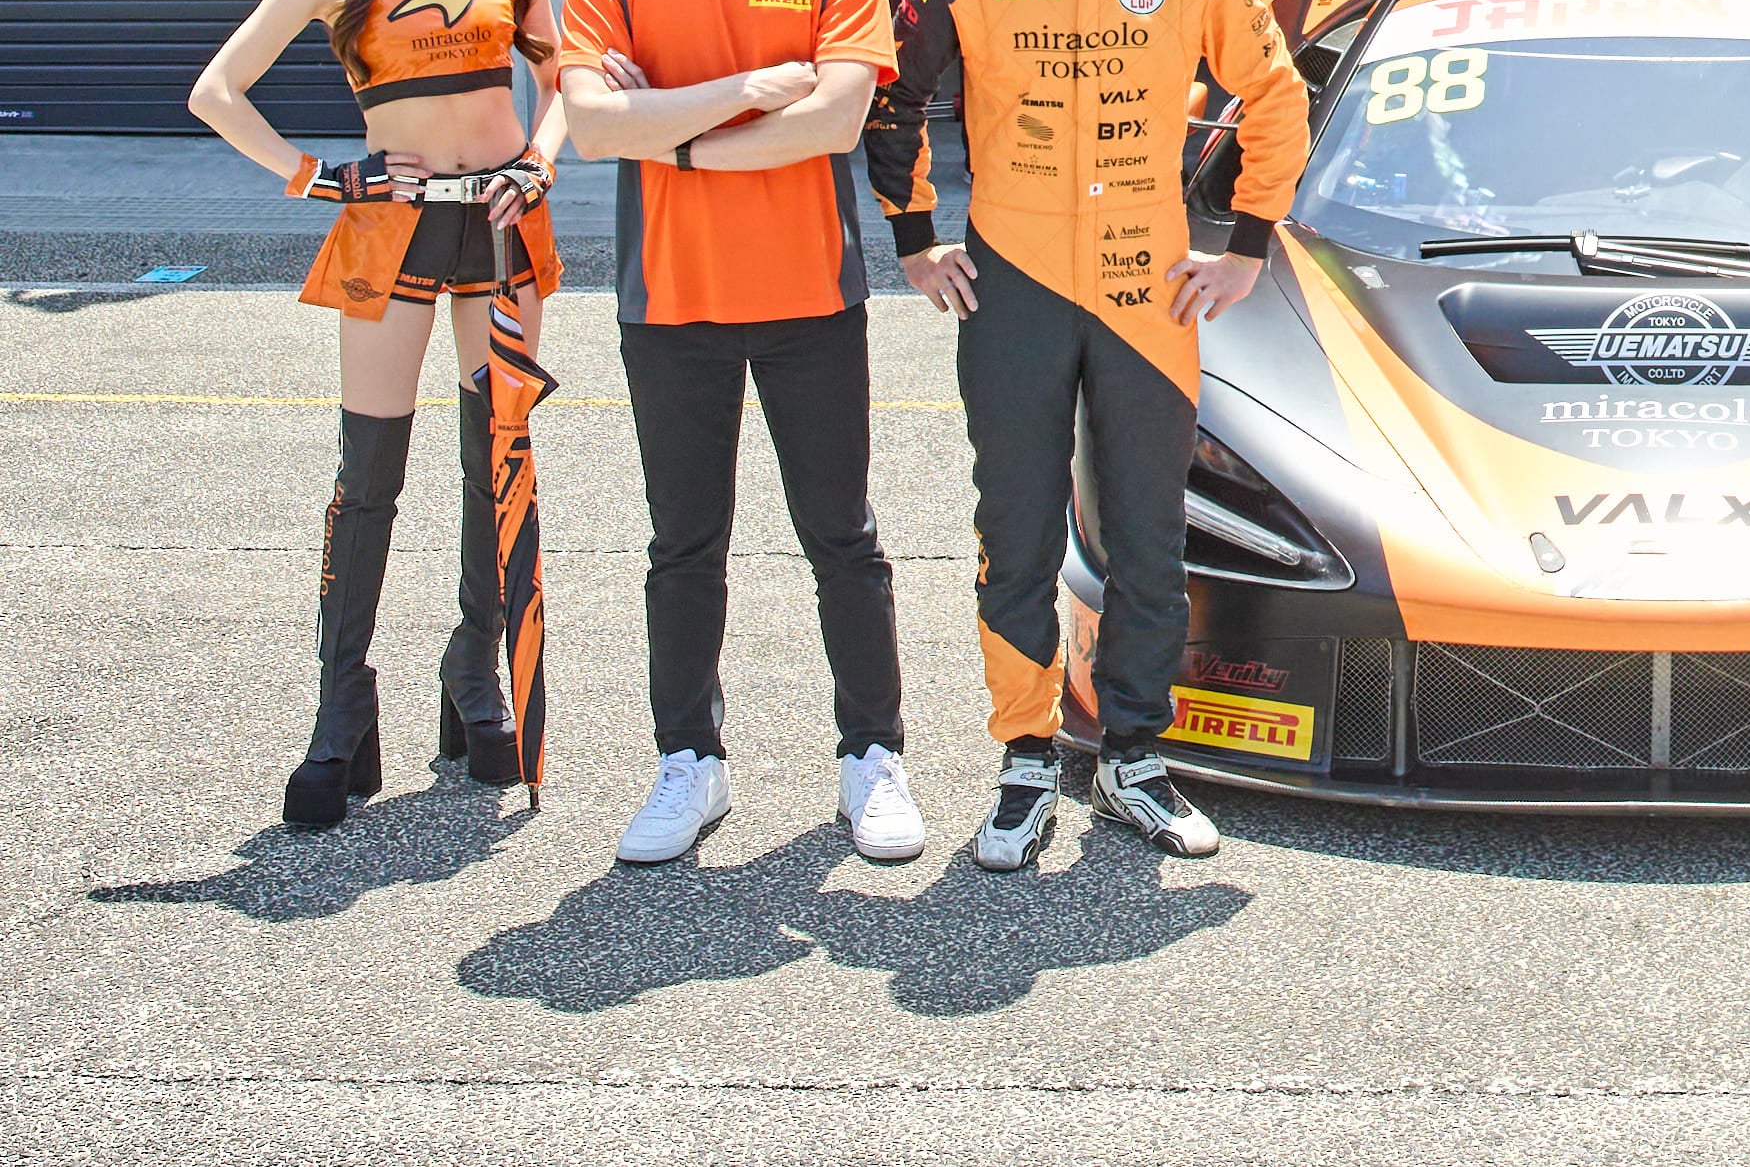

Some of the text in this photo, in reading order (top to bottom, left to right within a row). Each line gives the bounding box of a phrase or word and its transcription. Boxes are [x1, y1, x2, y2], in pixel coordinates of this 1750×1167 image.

[411, 26, 492, 50] miracolo
[1013, 22, 1149, 50] miracolo
[427, 47, 479, 61] TOKYO
[1036, 57, 1124, 79] TOKYO
[1099, 88, 1149, 105] VALX
[1365, 46, 1490, 126] 88
[1098, 118, 1148, 140] BPX
[1096, 155, 1149, 168] LEVECHY
[1119, 225, 1151, 236] Amber
[1101, 252, 1134, 270] Map
[1102, 267, 1153, 280] FINANCIAL
[1105, 286, 1153, 308] Y&K
[1622, 294, 1715, 321] MOTORCYCLE
[1648, 316, 1686, 327] TOKYO
[1598, 334, 1744, 360] UEMATSU
[1582, 428, 1739, 452] TOKYO
[1189, 650, 1291, 693] Verity
[1173, 697, 1300, 747] PIRELLI
